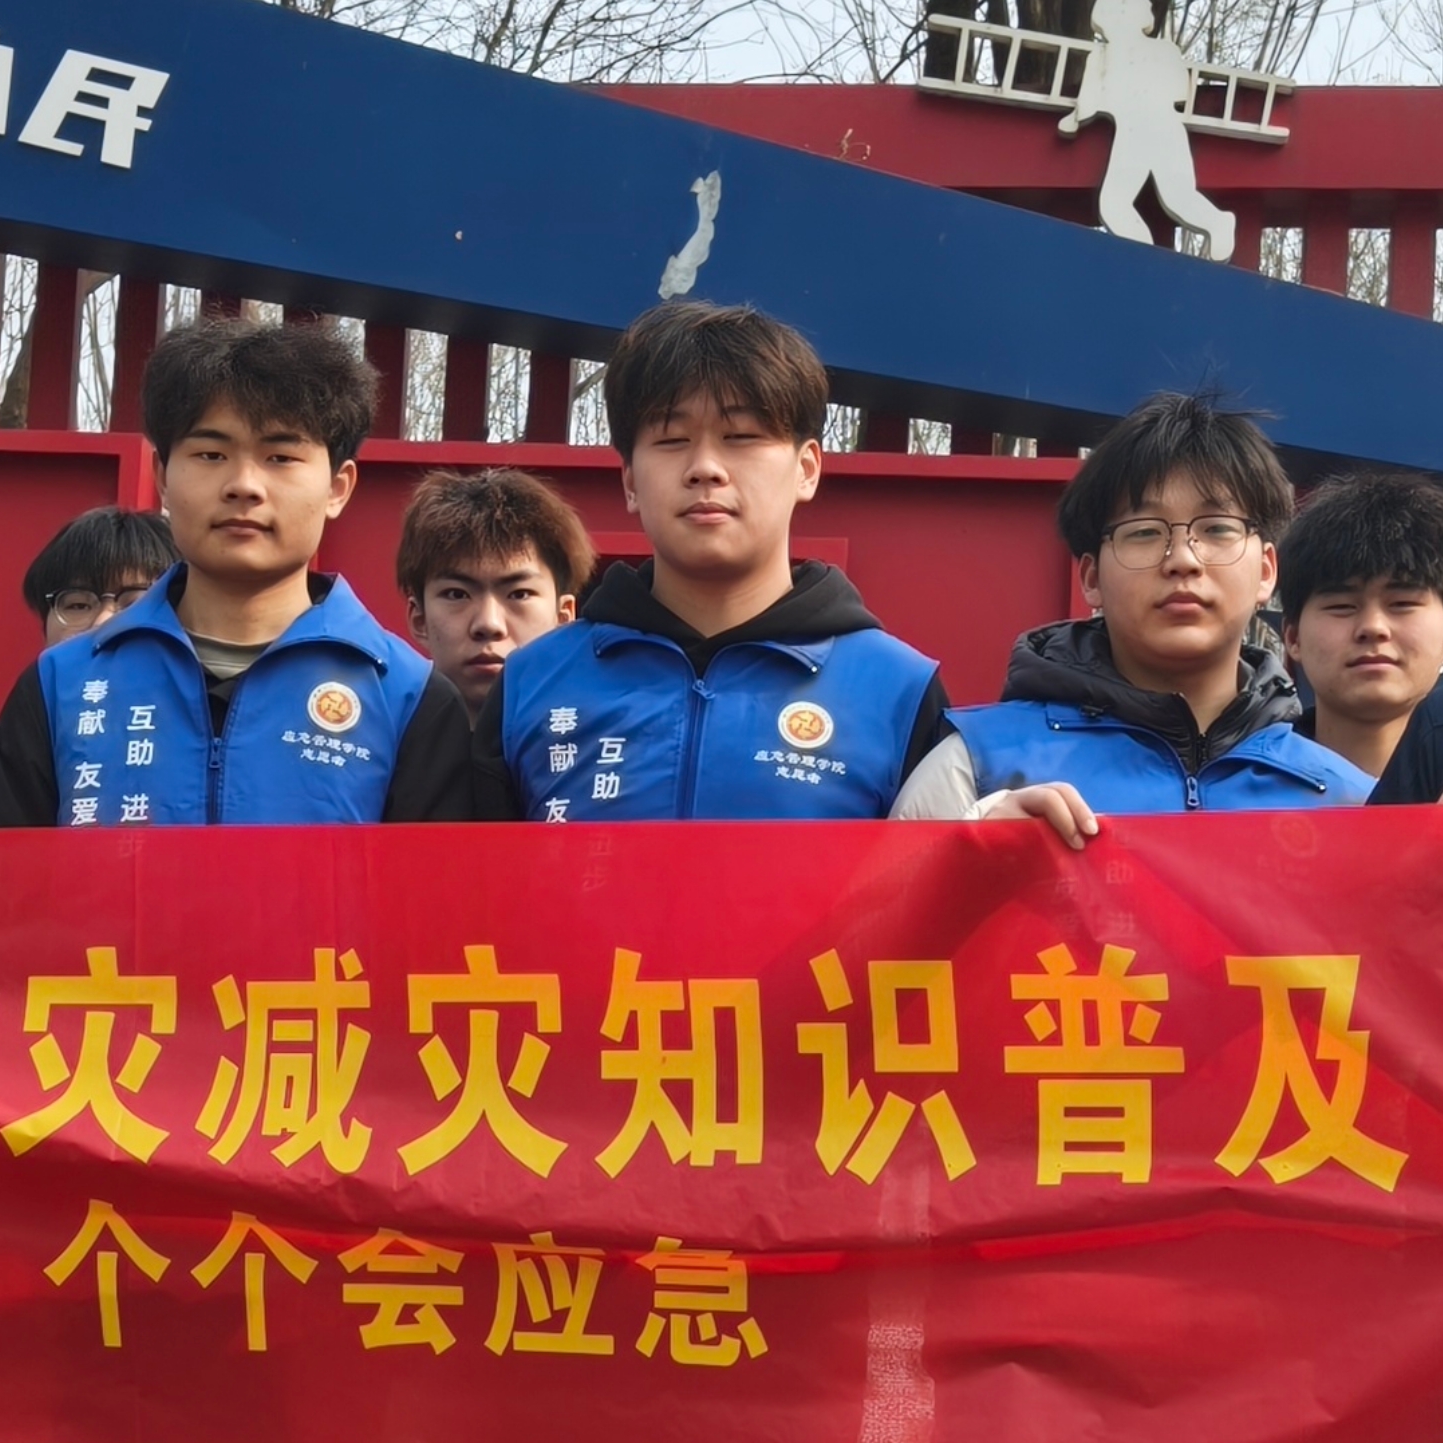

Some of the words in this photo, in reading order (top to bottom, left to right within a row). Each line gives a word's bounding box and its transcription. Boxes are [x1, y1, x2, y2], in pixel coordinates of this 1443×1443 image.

[77, 679, 108, 735] 奉献
[125, 705, 156, 766] 互助
[548, 706, 578, 773] 奉献
[591, 737, 626, 800] 互助
[44, 1199, 769, 1367] 个个会应急
